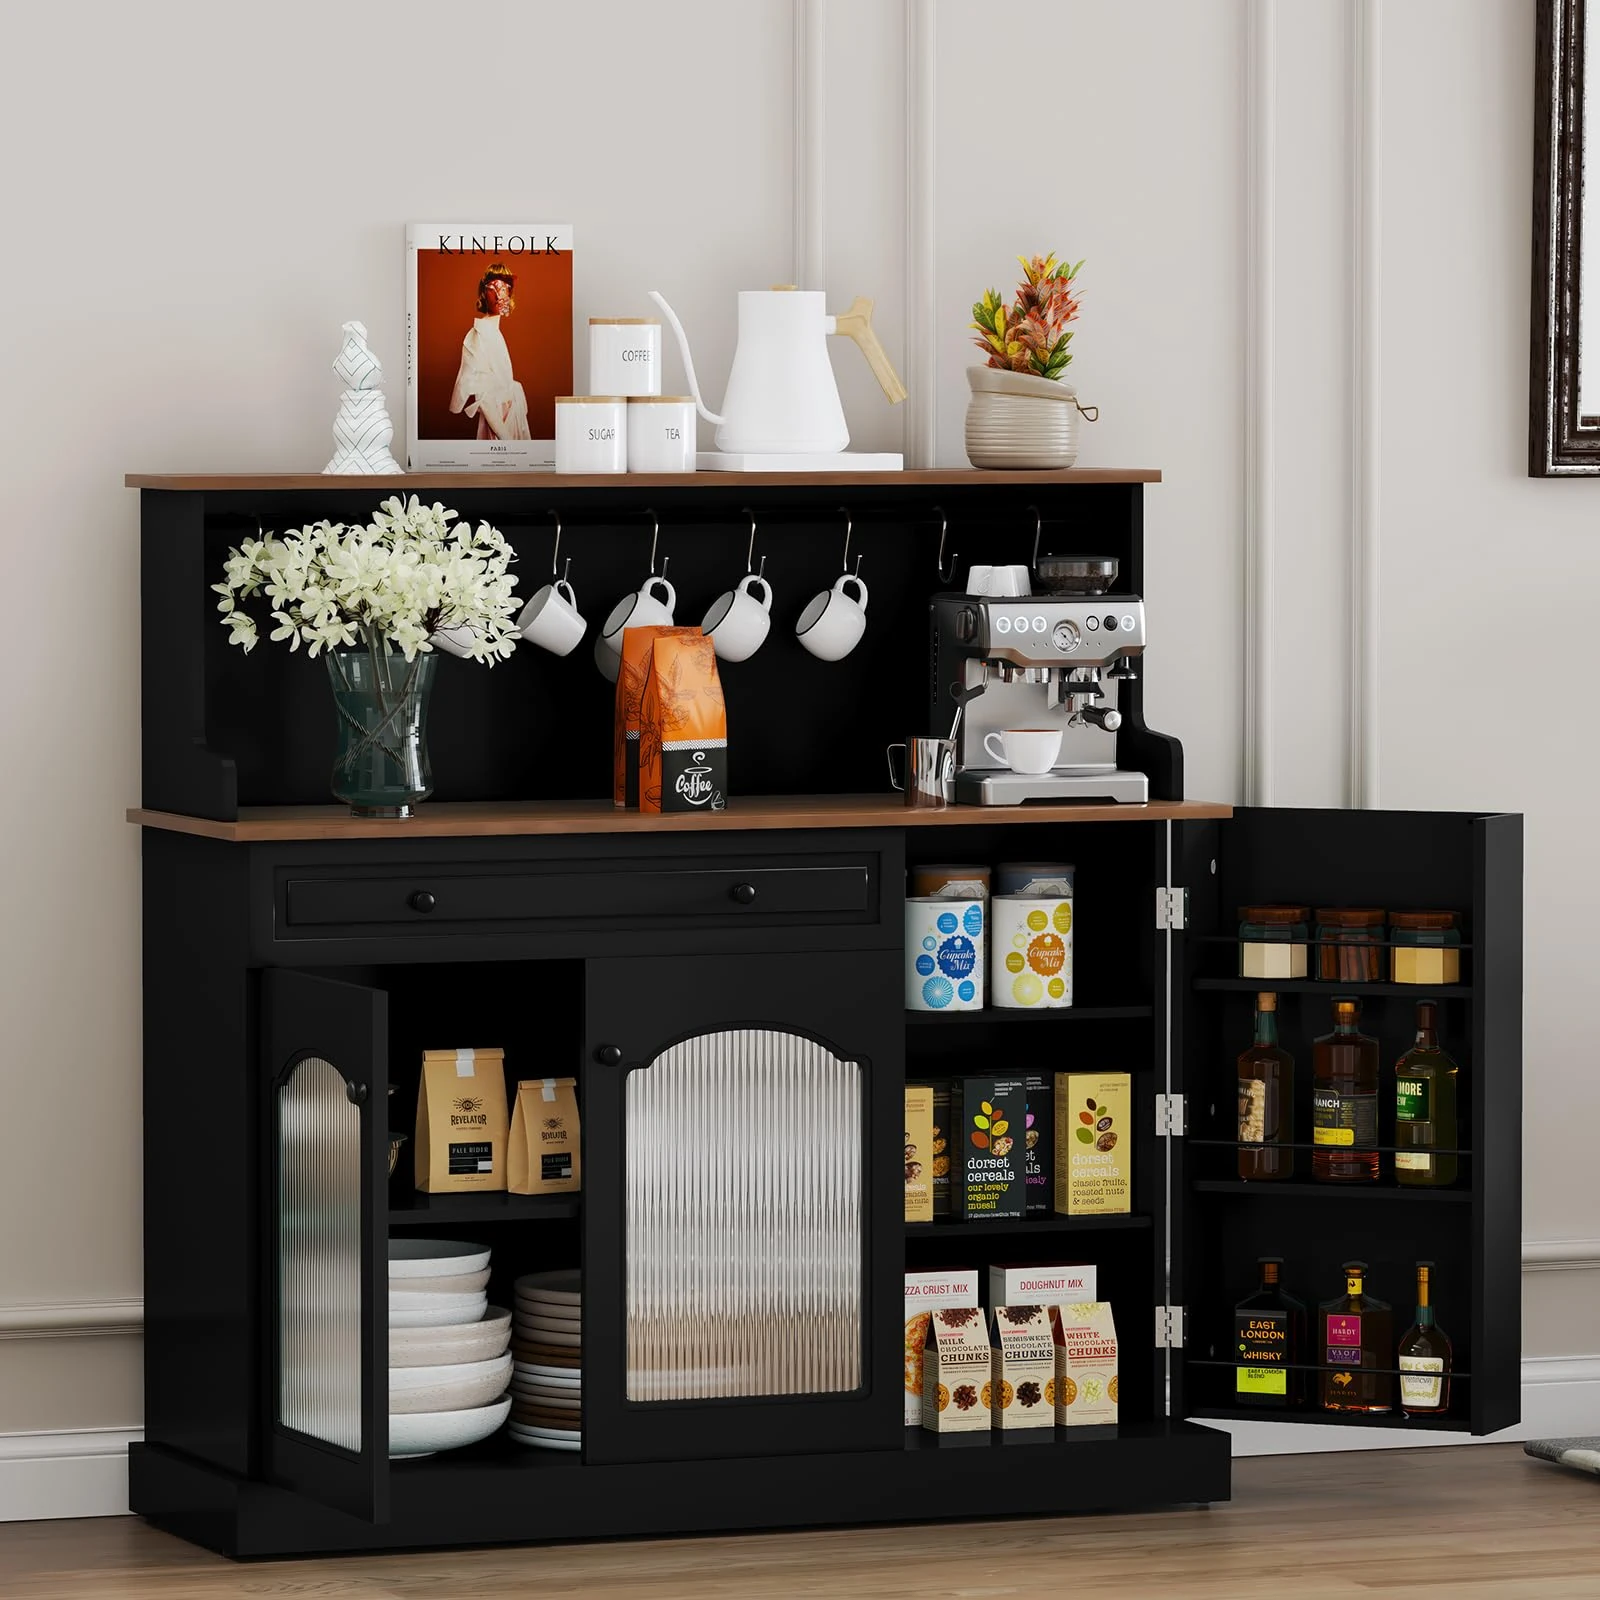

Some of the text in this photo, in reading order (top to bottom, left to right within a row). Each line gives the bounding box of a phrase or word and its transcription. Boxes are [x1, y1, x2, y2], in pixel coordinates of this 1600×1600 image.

[438, 235, 560, 255] KINFOLK
[622, 350, 651, 361] COFFEE
[665, 429, 680, 439] TEA
[675, 774, 713, 798] Coffee
[940, 949, 974, 962] Cupcake
[1030, 946, 1064, 959] Cupcake
[950, 960, 970, 971] Mix
[1040, 957, 1060, 968] Mix
[450, 1114, 487, 1126] REVELATOR
[967, 1156, 1010, 1169] dorset
[1072, 1153, 1113, 1165] dorset
[967, 1169, 1015, 1182] cereals
[1072, 1165, 1119, 1177] cereals
[984, 1183, 1009, 1191] lovely
[1072, 1188, 1104, 1196] roasted
[967, 1193, 999, 1201] organic
[1072, 1197, 1105, 1205] & seeds
[967, 1201, 996, 1209] muesli
[904, 1284, 969, 1296] ZZA CRUST MIX
[1020, 1279, 1083, 1291] DOUGHNUT MIX
[1249, 1320, 1276, 1330] EAST
[1066, 1331, 1100, 1339] WHITE
[1240, 1330, 1285, 1339] LONDON
[1067, 1339, 1116, 1347] CHOCOLATE
[1005, 1350, 1053, 1359] CHUNKS
[1068, 1346, 1116, 1356] CHUNKS
[1243, 1351, 1282, 1360] WHISKY
[940, 1352, 989, 1362] CHUNKS
